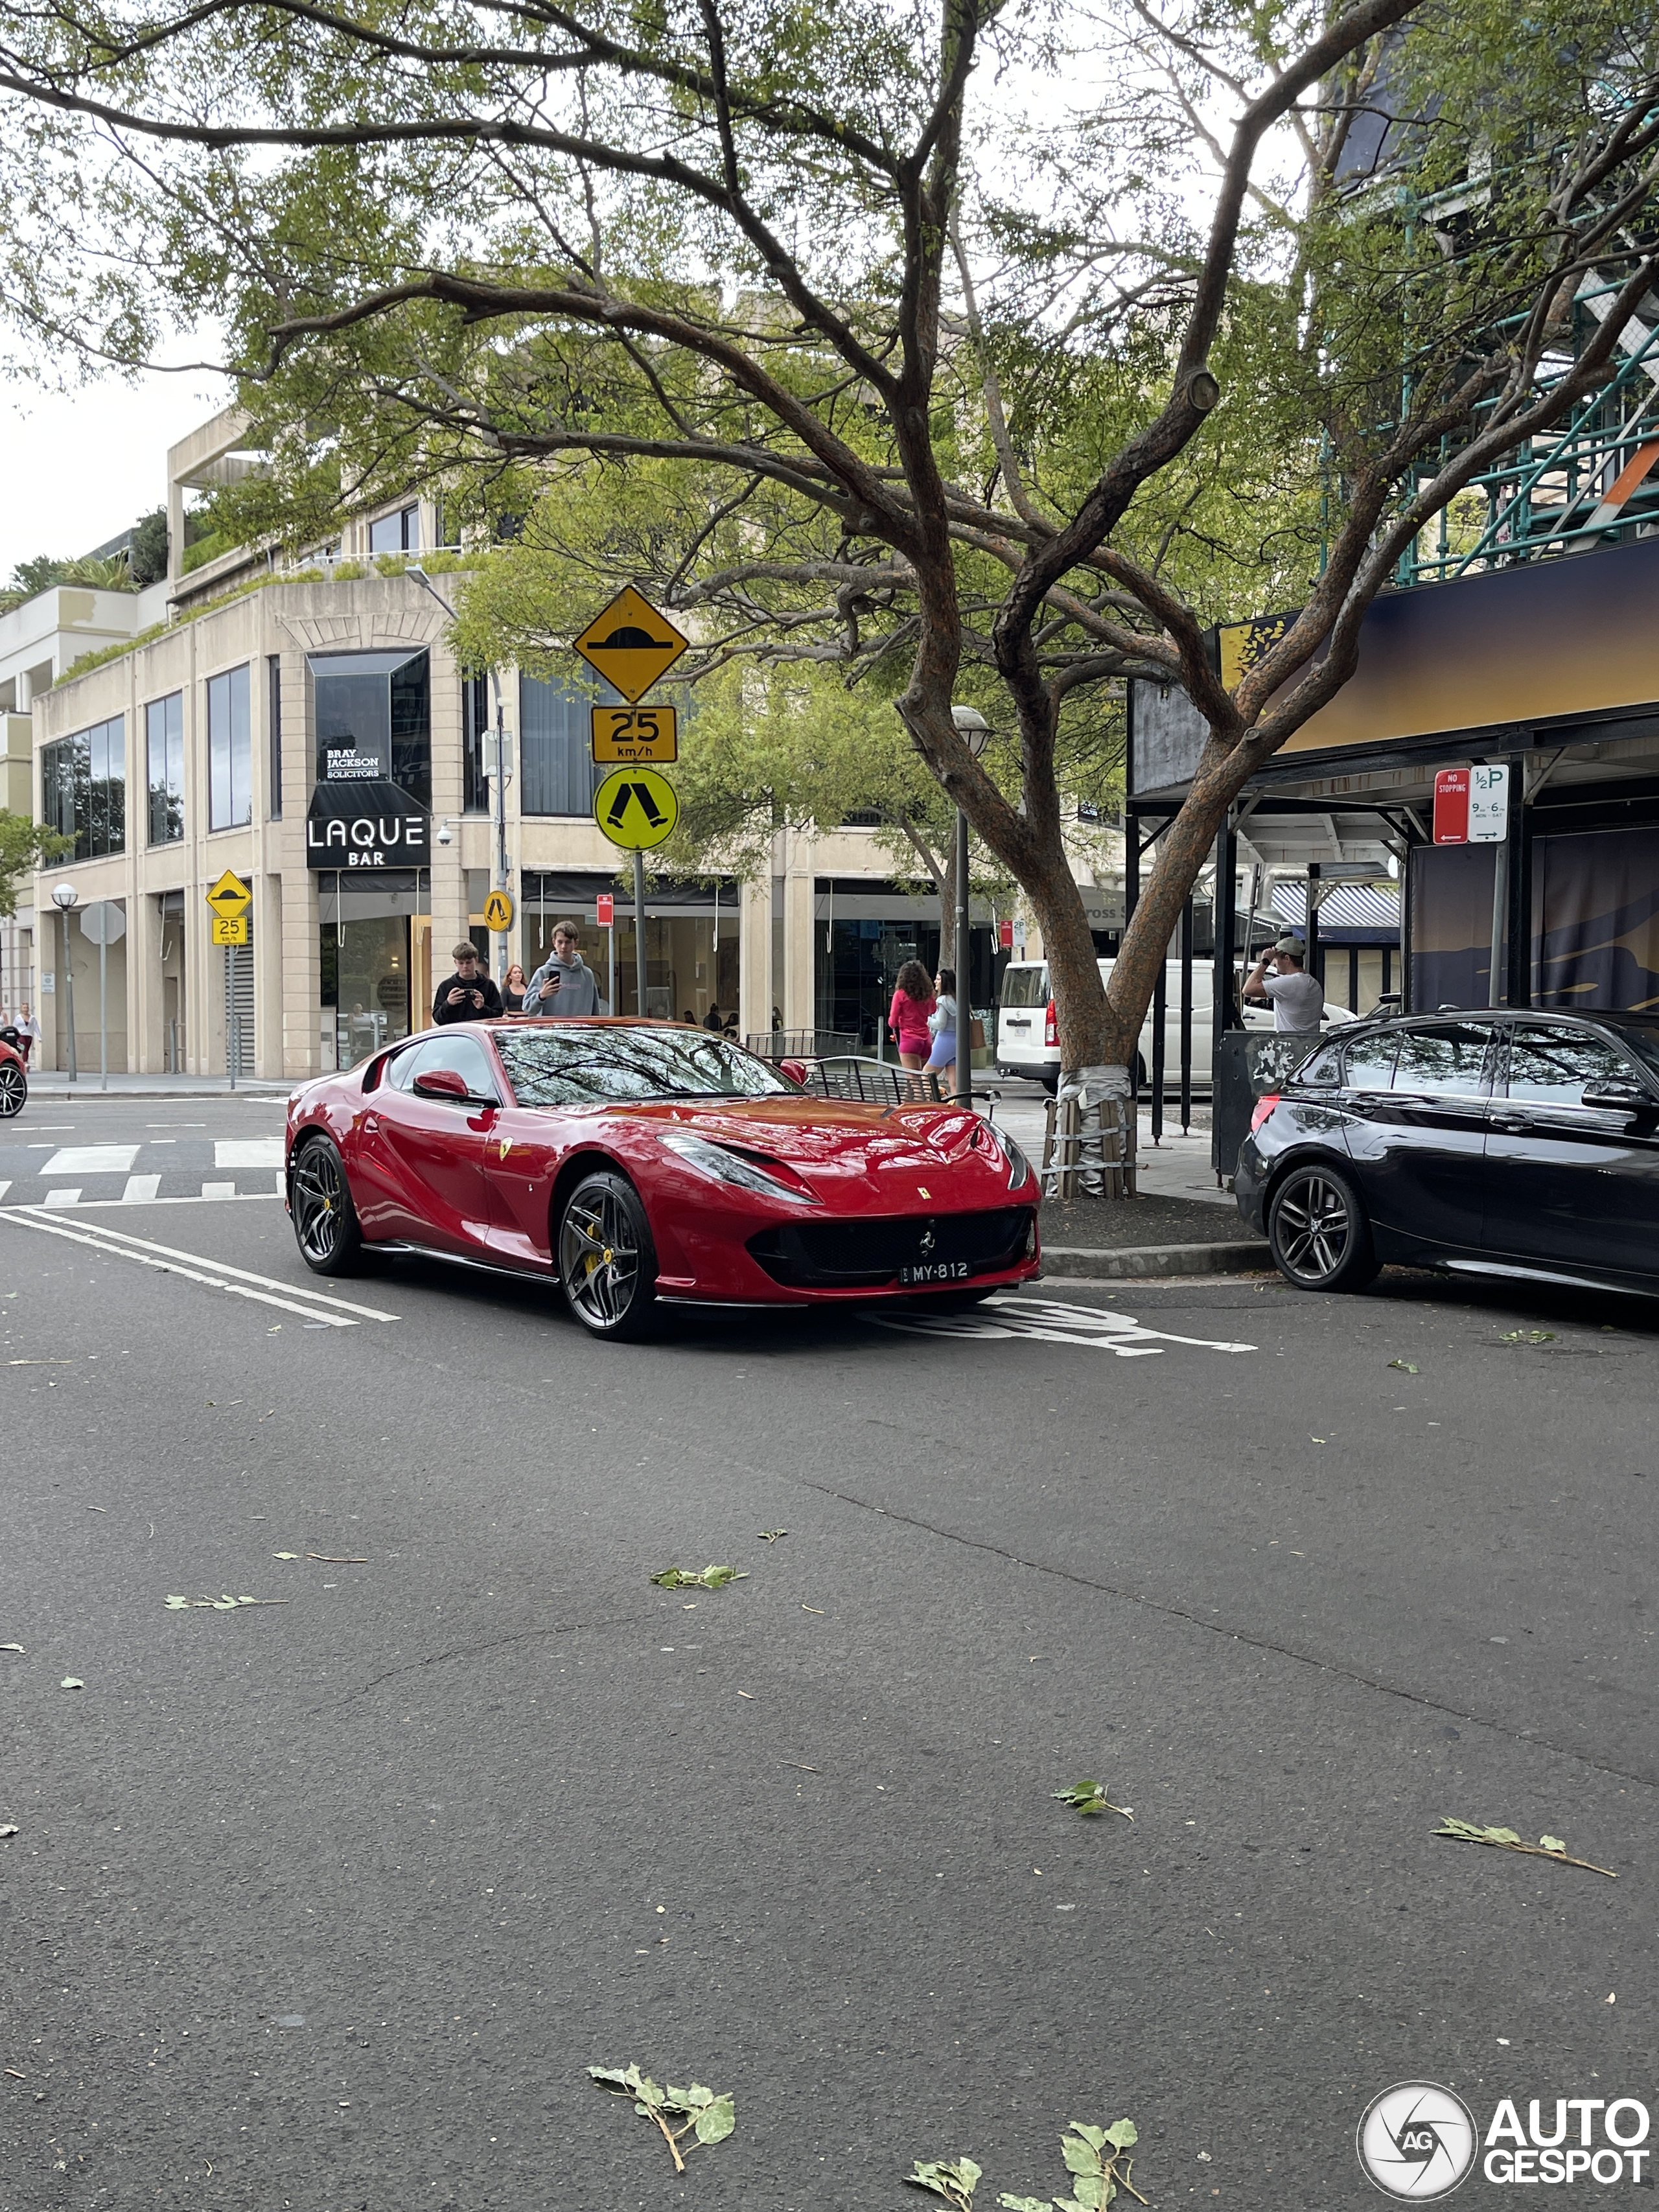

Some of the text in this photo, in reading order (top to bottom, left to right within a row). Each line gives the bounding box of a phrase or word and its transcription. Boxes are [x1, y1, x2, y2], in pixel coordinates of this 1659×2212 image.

[610, 712, 659, 742] 25
[327, 749, 356, 759] BRAY
[618, 746, 653, 756] km/h
[327, 758, 379, 769] JACKSON
[327, 769, 379, 779] SOLICITORS
[1448, 774, 1457, 782] NO
[1439, 784, 1466, 793] STOPPING
[308, 817, 423, 848] LAQUE
[348, 851, 386, 867] BAR
[1085, 909, 1116, 918] ross
[220, 920, 240, 934] 25
